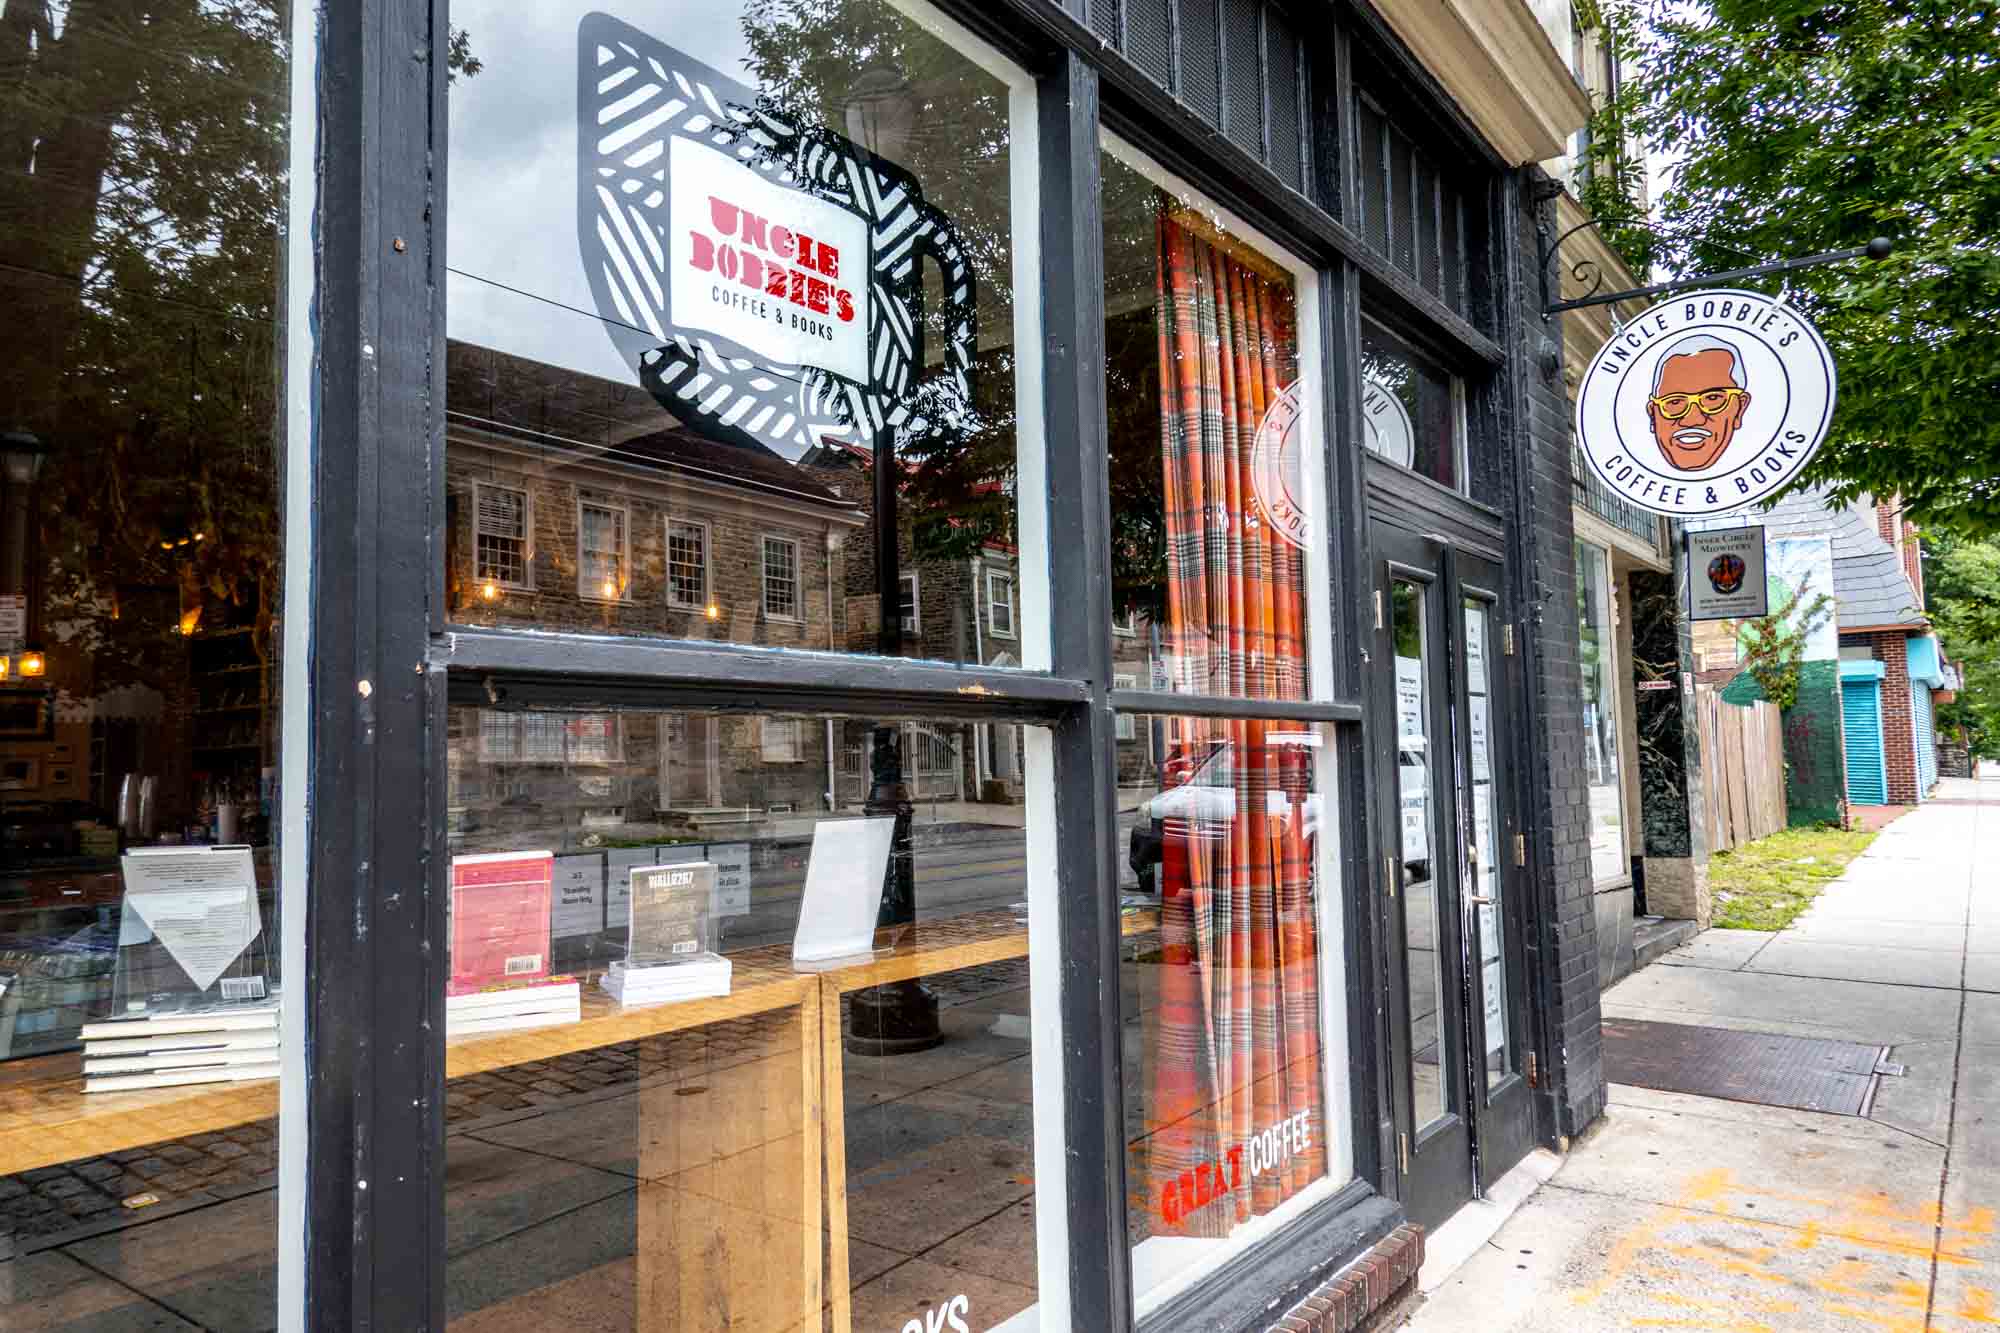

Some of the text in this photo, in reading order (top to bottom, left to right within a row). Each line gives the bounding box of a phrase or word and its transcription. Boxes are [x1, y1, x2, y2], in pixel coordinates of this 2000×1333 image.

[689, 230, 854, 322] BOBBIE'S
[708, 195, 839, 280] UNCLE
[712, 285, 833, 341] COFFEE & BOOKS
[1601, 300, 1799, 374] UNCLE BOBBIE'S
[1605, 430, 1806, 505] COFFEE & BOOKS
[1162, 1109, 1312, 1226] GREAT COFFEE
